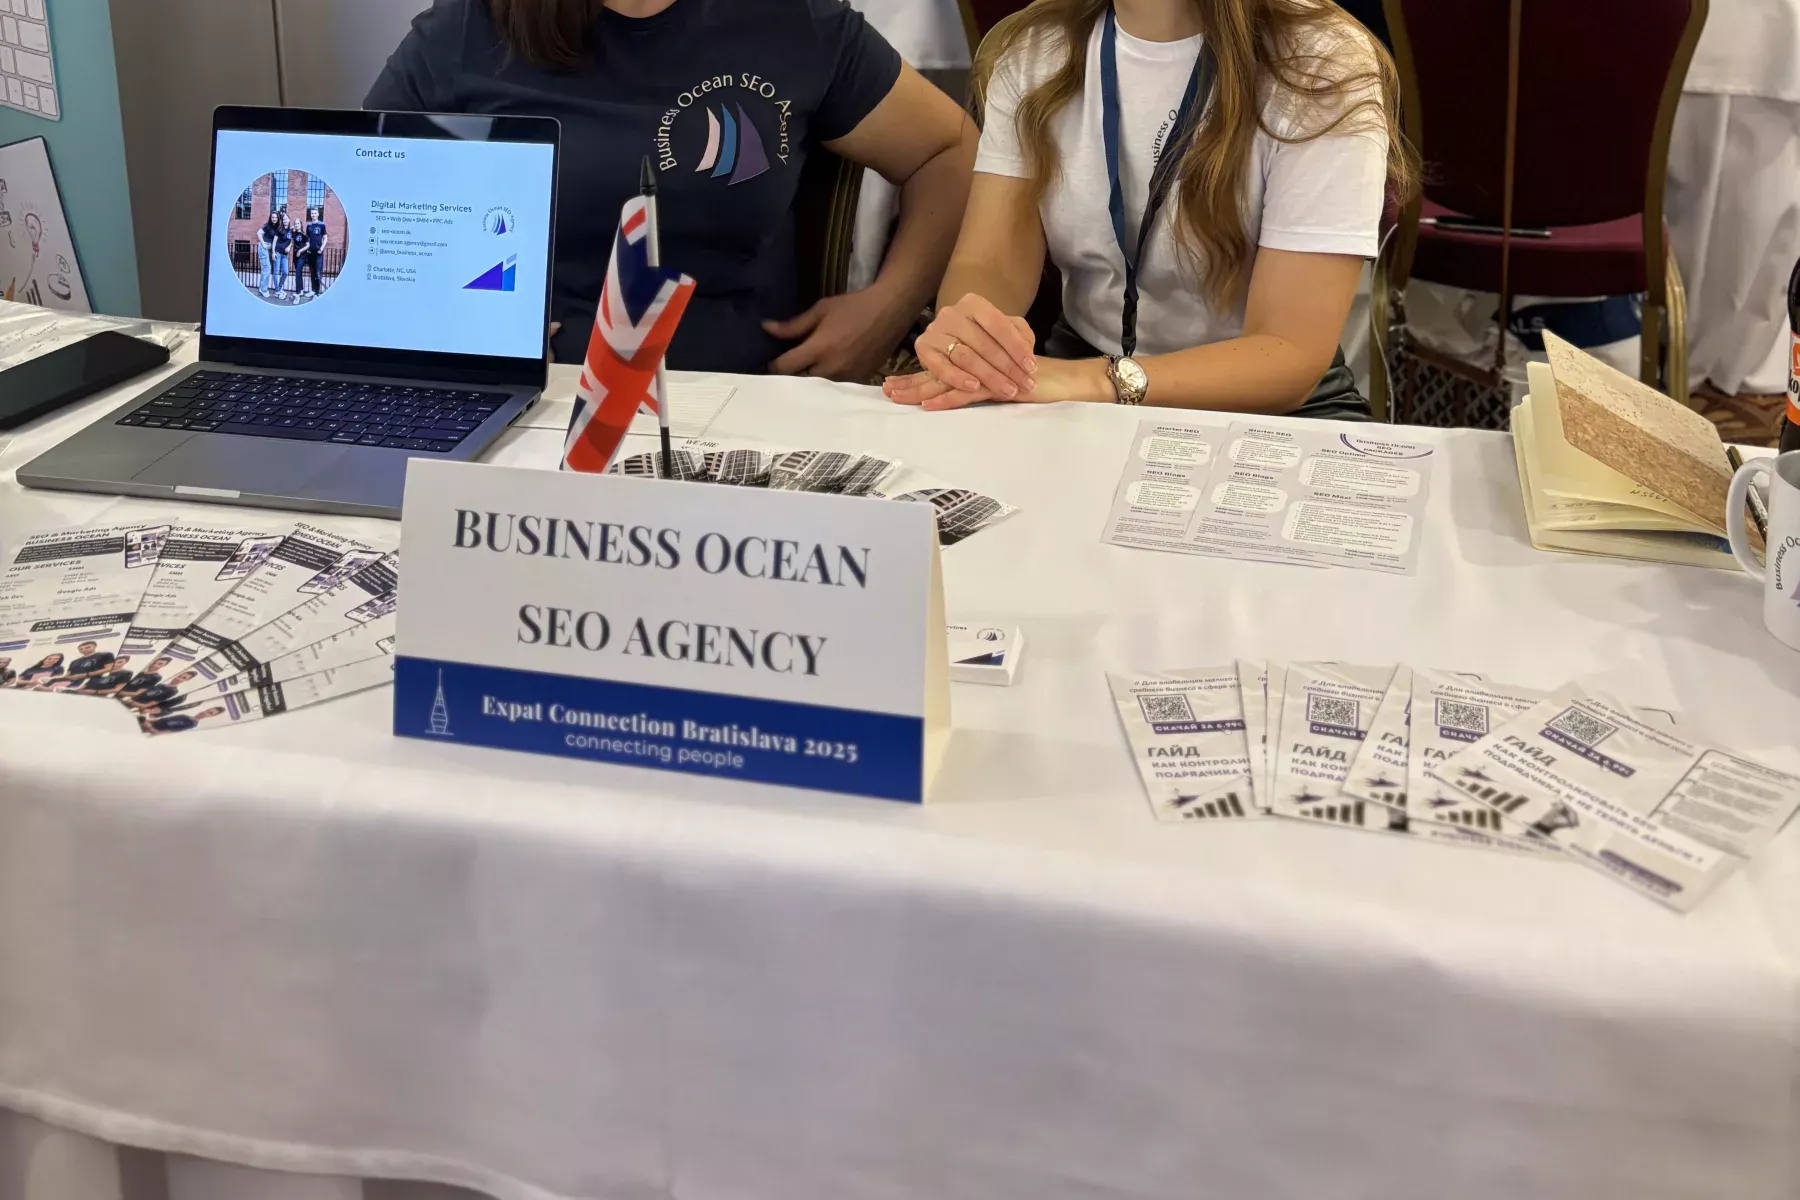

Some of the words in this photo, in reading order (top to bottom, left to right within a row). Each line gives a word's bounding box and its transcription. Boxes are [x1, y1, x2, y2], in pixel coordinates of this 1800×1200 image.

[653, 107, 680, 172] Business
[677, 74, 733, 108] Ocean
[740, 72, 776, 98] SEO
[774, 100, 792, 165] Agency
[355, 148, 392, 158] Contact
[394, 150, 406, 159] us
[1152, 120, 1169, 170] usiness
[371, 200, 396, 210] Digital
[398, 202, 438, 213] Marketing
[439, 203, 472, 213] Services
[452, 508, 681, 571] BUSINESS
[695, 531, 871, 589] OCEAN
[1773, 542, 1787, 591] Business
[517, 603, 611, 652] SEO
[622, 616, 828, 676] AGENCY
[482, 694, 544, 722] Expat
[549, 702, 675, 738] Connection
[682, 718, 798, 754] Bratislava
[804, 739, 859, 764] 2025
[1155, 723, 1199, 731] СКАЧАЙ
[1312, 725, 1357, 737] СКАЧАЙ
[1442, 730, 1481, 742] СКАЧА
[565, 731, 672, 762] connecting
[678, 745, 745, 769] people
[1376, 744, 1402, 757] КАК
[1544, 729, 1586, 753] СКАЧАЙ
[1147, 744, 1201, 759] ГАЙД
[1292, 743, 1347, 763] ГАЙД
[1372, 752, 1409, 767] ПОДР
[1492, 743, 1520, 762] КАК
[1502, 735, 1557, 768] ГАЙД
[1155, 768, 1239, 779] ПОДРЯДЧИКА
[1291, 757, 1317, 768] КАК
[1320, 762, 1351, 772] КОН
[1482, 749, 1563, 796] ПОДРЯДЧИКА
[1290, 767, 1346, 782] ПОДРЯД
